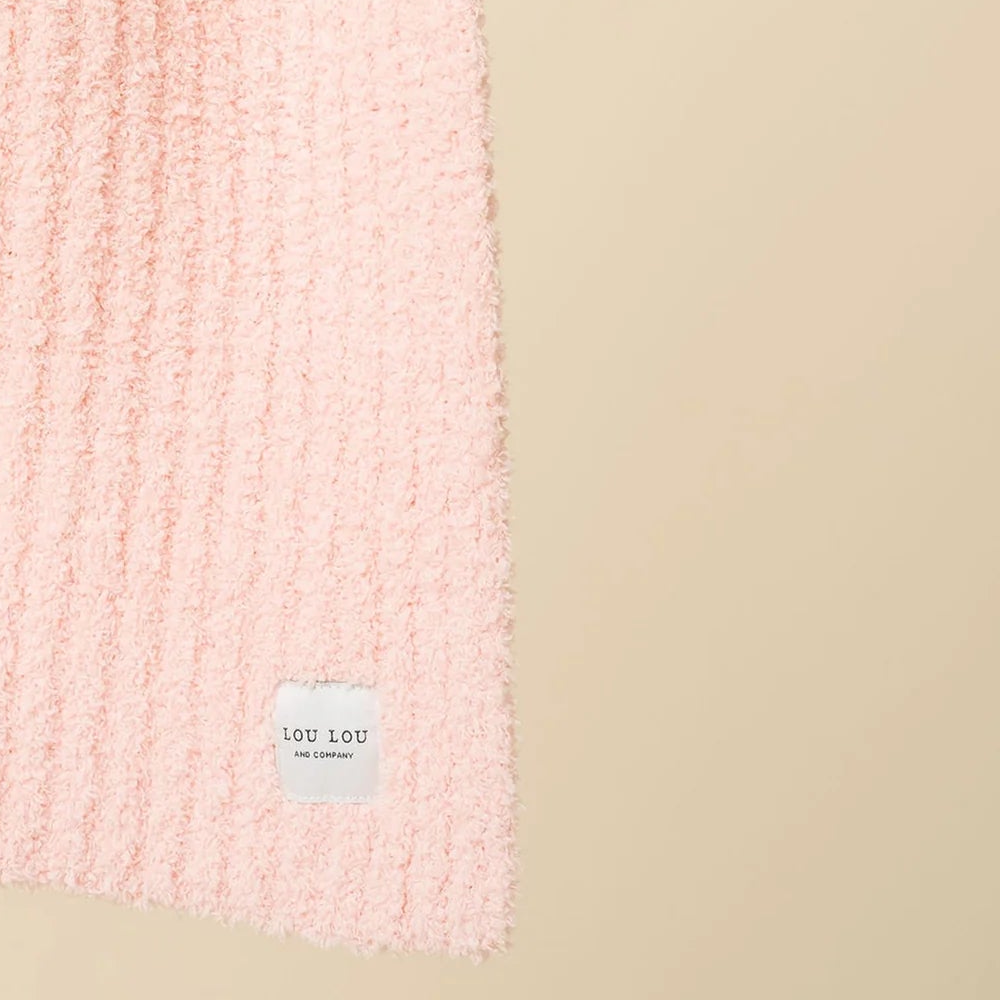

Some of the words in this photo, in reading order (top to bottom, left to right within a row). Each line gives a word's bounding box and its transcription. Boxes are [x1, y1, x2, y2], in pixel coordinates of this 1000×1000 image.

[283, 727, 318, 743] LOU
[328, 729, 368, 744] LOU
[294, 750, 311, 759] AND
[313, 751, 354, 759] COMPANY
